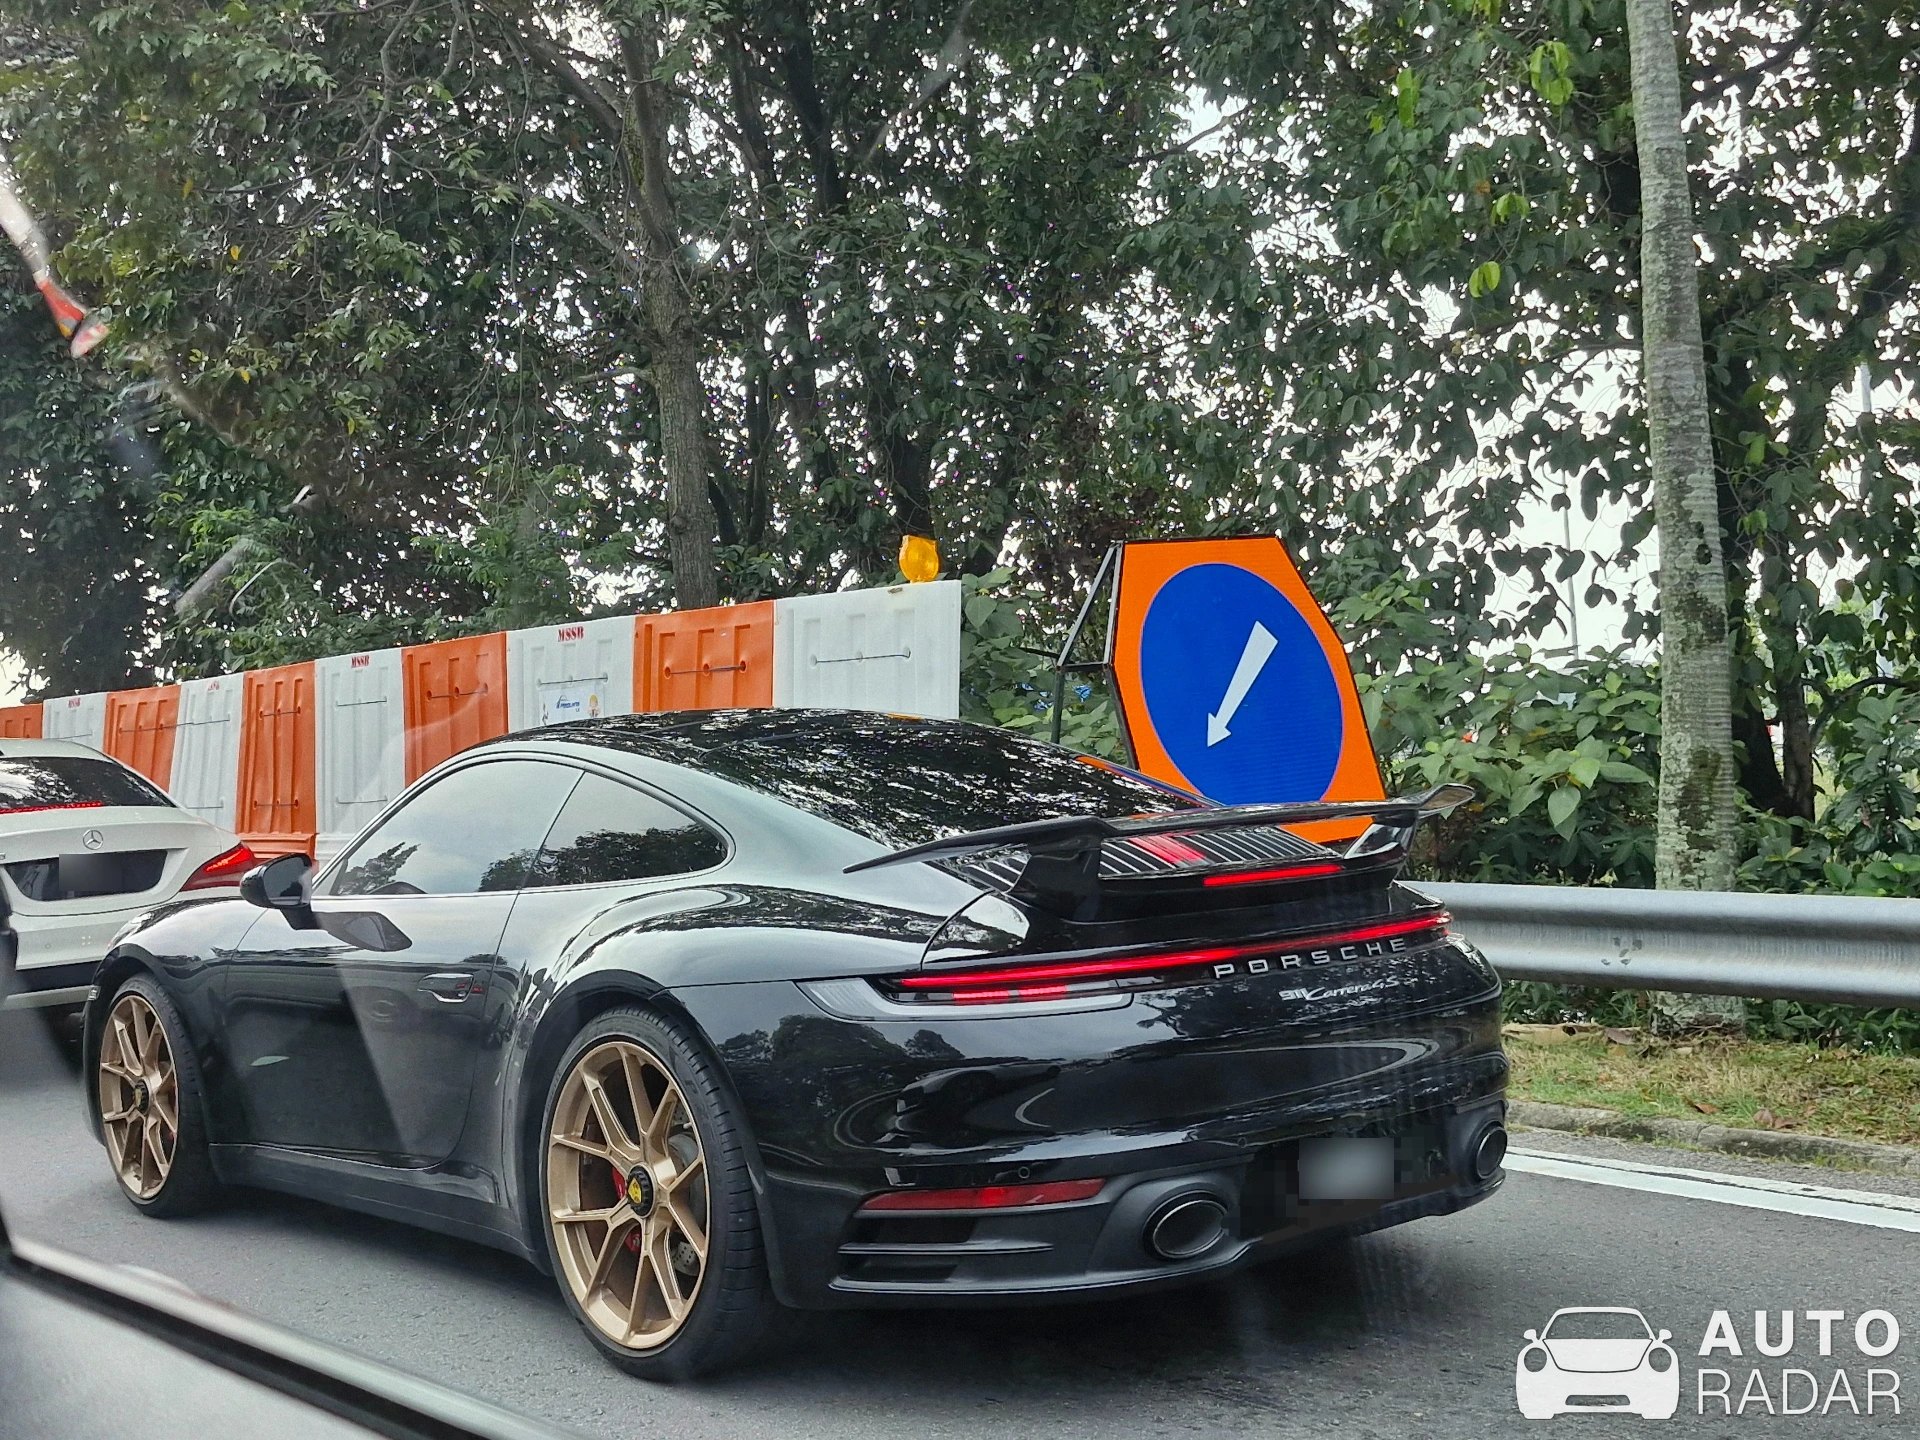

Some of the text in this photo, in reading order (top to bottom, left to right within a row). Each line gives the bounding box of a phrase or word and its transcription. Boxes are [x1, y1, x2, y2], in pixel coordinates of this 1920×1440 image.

[558, 626, 584, 642] MSSB
[1213, 938, 1407, 979] PORSCHE
[1278, 975, 1400, 1001] 911 Carrera 4S
